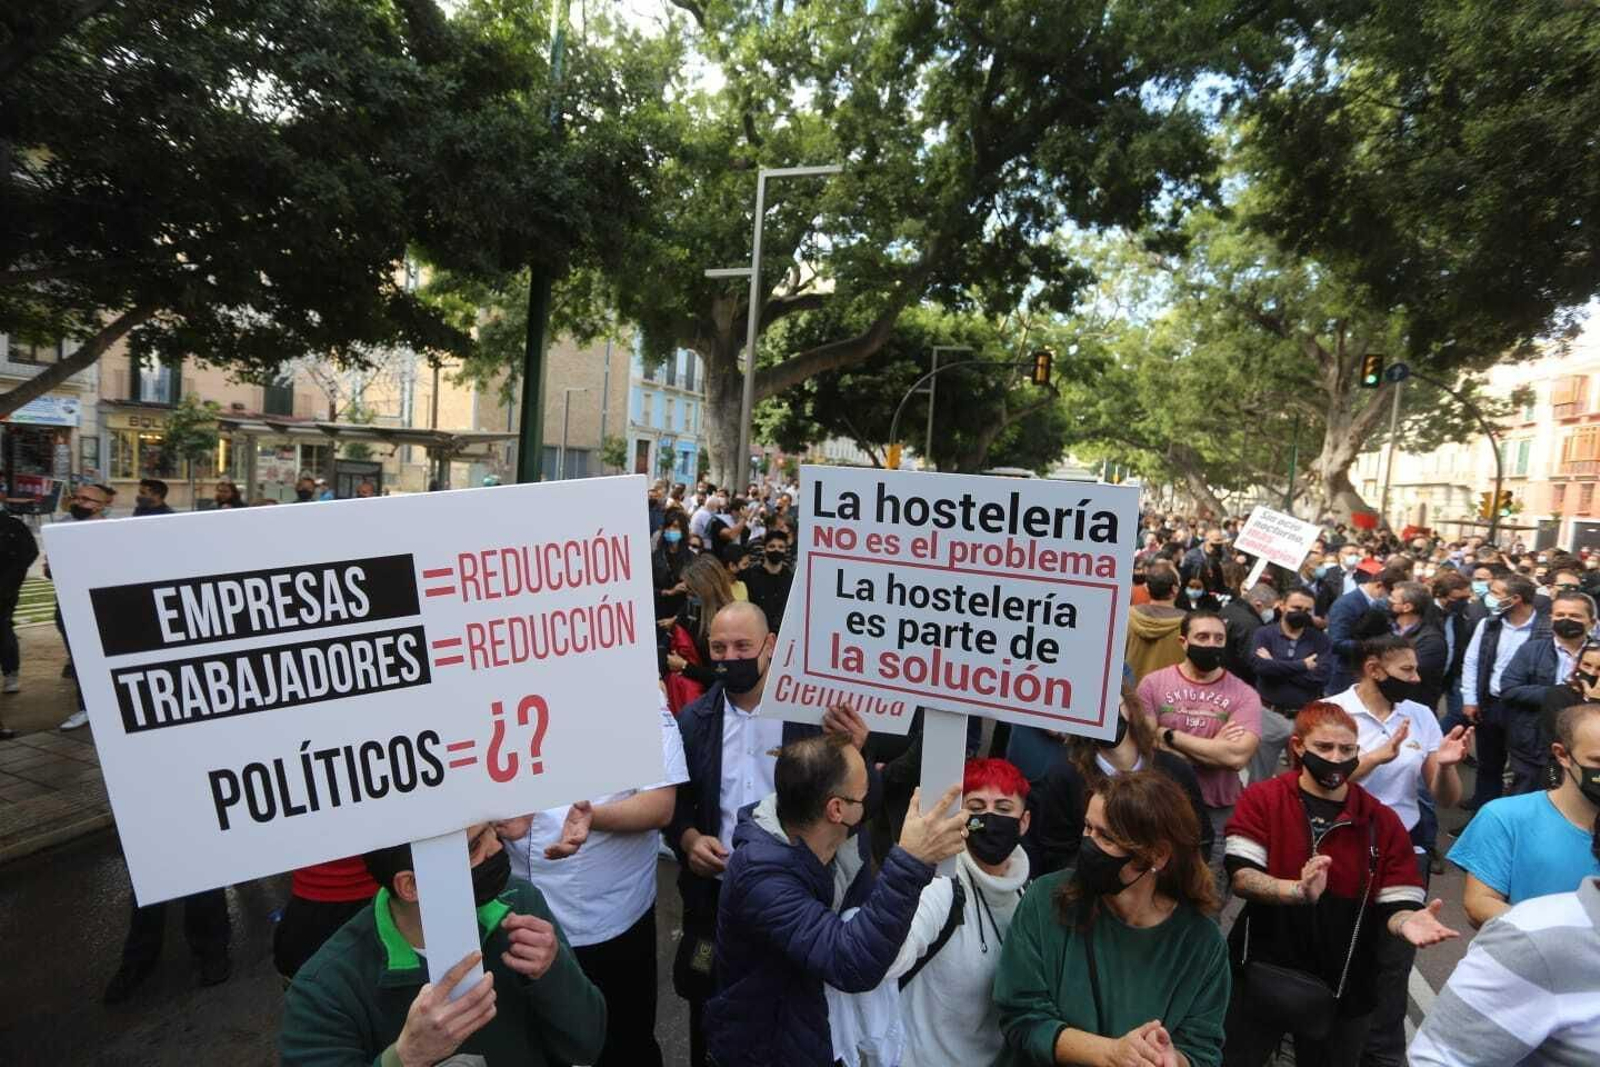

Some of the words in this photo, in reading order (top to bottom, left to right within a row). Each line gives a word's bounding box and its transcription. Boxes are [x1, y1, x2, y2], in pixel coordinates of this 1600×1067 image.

[814, 480, 860, 521] La
[876, 482, 1119, 544] hostelería
[813, 526, 857, 550] NO
[866, 533, 900, 554] es
[911, 531, 938, 559] el
[949, 535, 1117, 578] problema
[152, 565, 371, 644] EMPRESAS
[836, 568, 875, 602] La
[886, 572, 1078, 629] hostelería
[830, 633, 865, 675] la
[878, 647, 1073, 710] solución
[846, 611, 886, 639] es
[898, 617, 998, 656] parte
[1010, 626, 1061, 665] de
[117, 632, 422, 729] TRABAJADORES
[207, 729, 445, 832] POLÍTICOS
